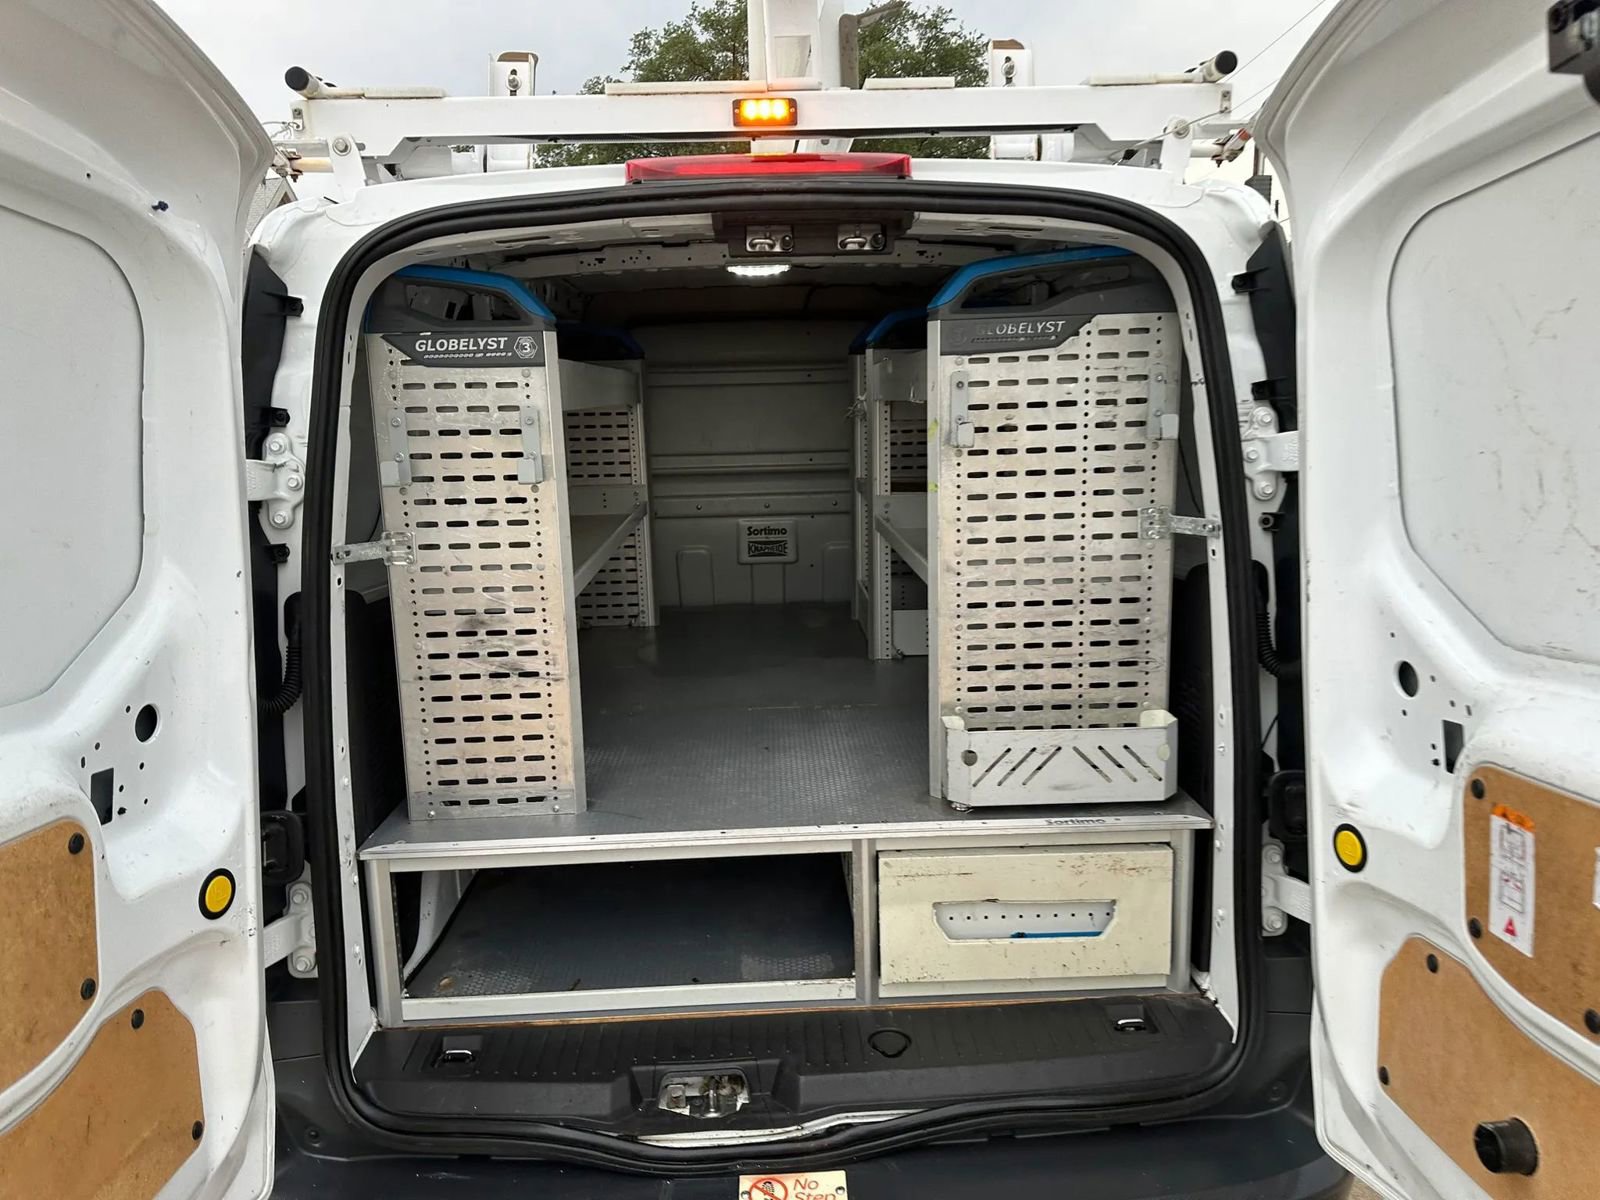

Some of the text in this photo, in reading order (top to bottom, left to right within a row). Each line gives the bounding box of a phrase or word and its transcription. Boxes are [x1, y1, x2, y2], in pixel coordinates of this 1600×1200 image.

[976, 321, 1066, 336] LOBELYST
[415, 337, 508, 352] GLOBELYST
[747, 525, 787, 536] Sortimo
[793, 1178, 819, 1191] No
